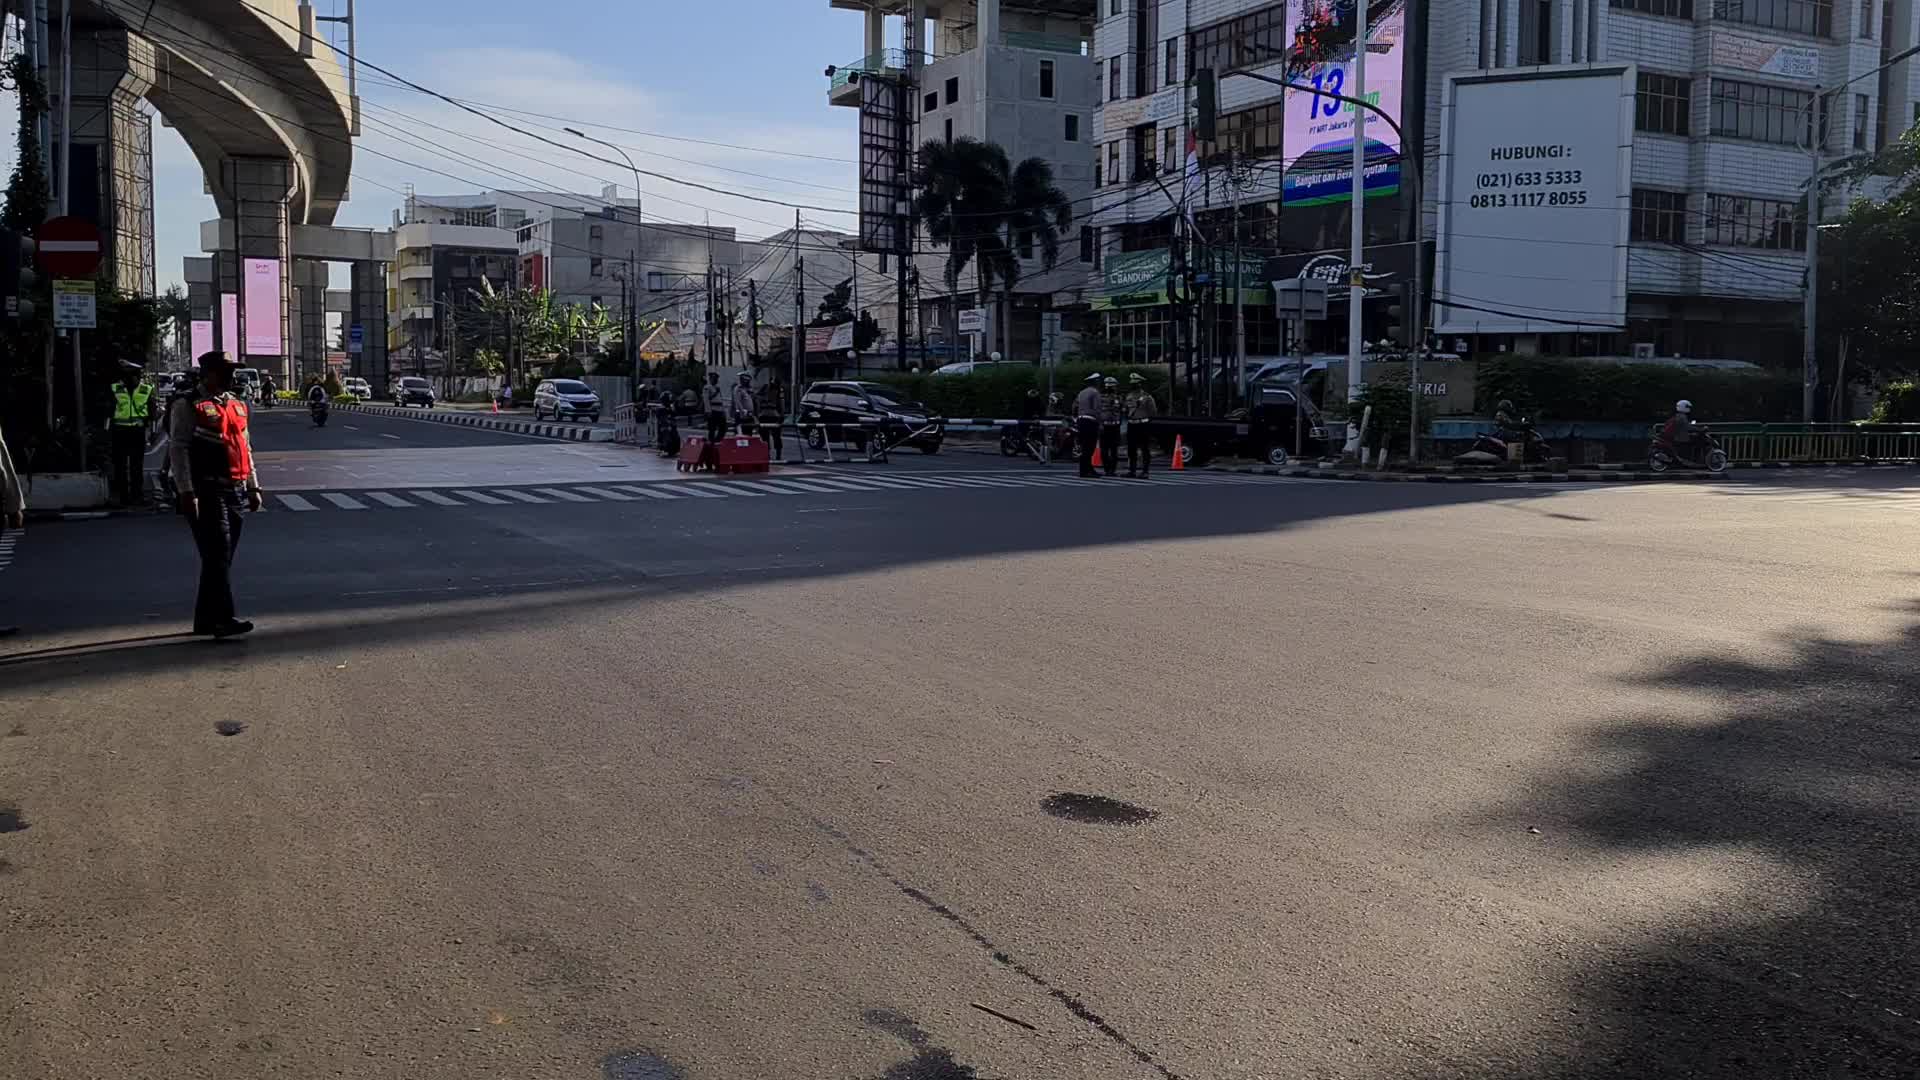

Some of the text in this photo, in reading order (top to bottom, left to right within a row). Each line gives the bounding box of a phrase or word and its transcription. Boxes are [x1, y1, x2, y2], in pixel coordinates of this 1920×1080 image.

[1310, 68, 1345, 119] 13
[1295, 174, 1322, 188] Bangkit
[1477, 170, 1582, 189] (021) 633 5333
[1470, 191, 1587, 208] 0813 1117 8055
